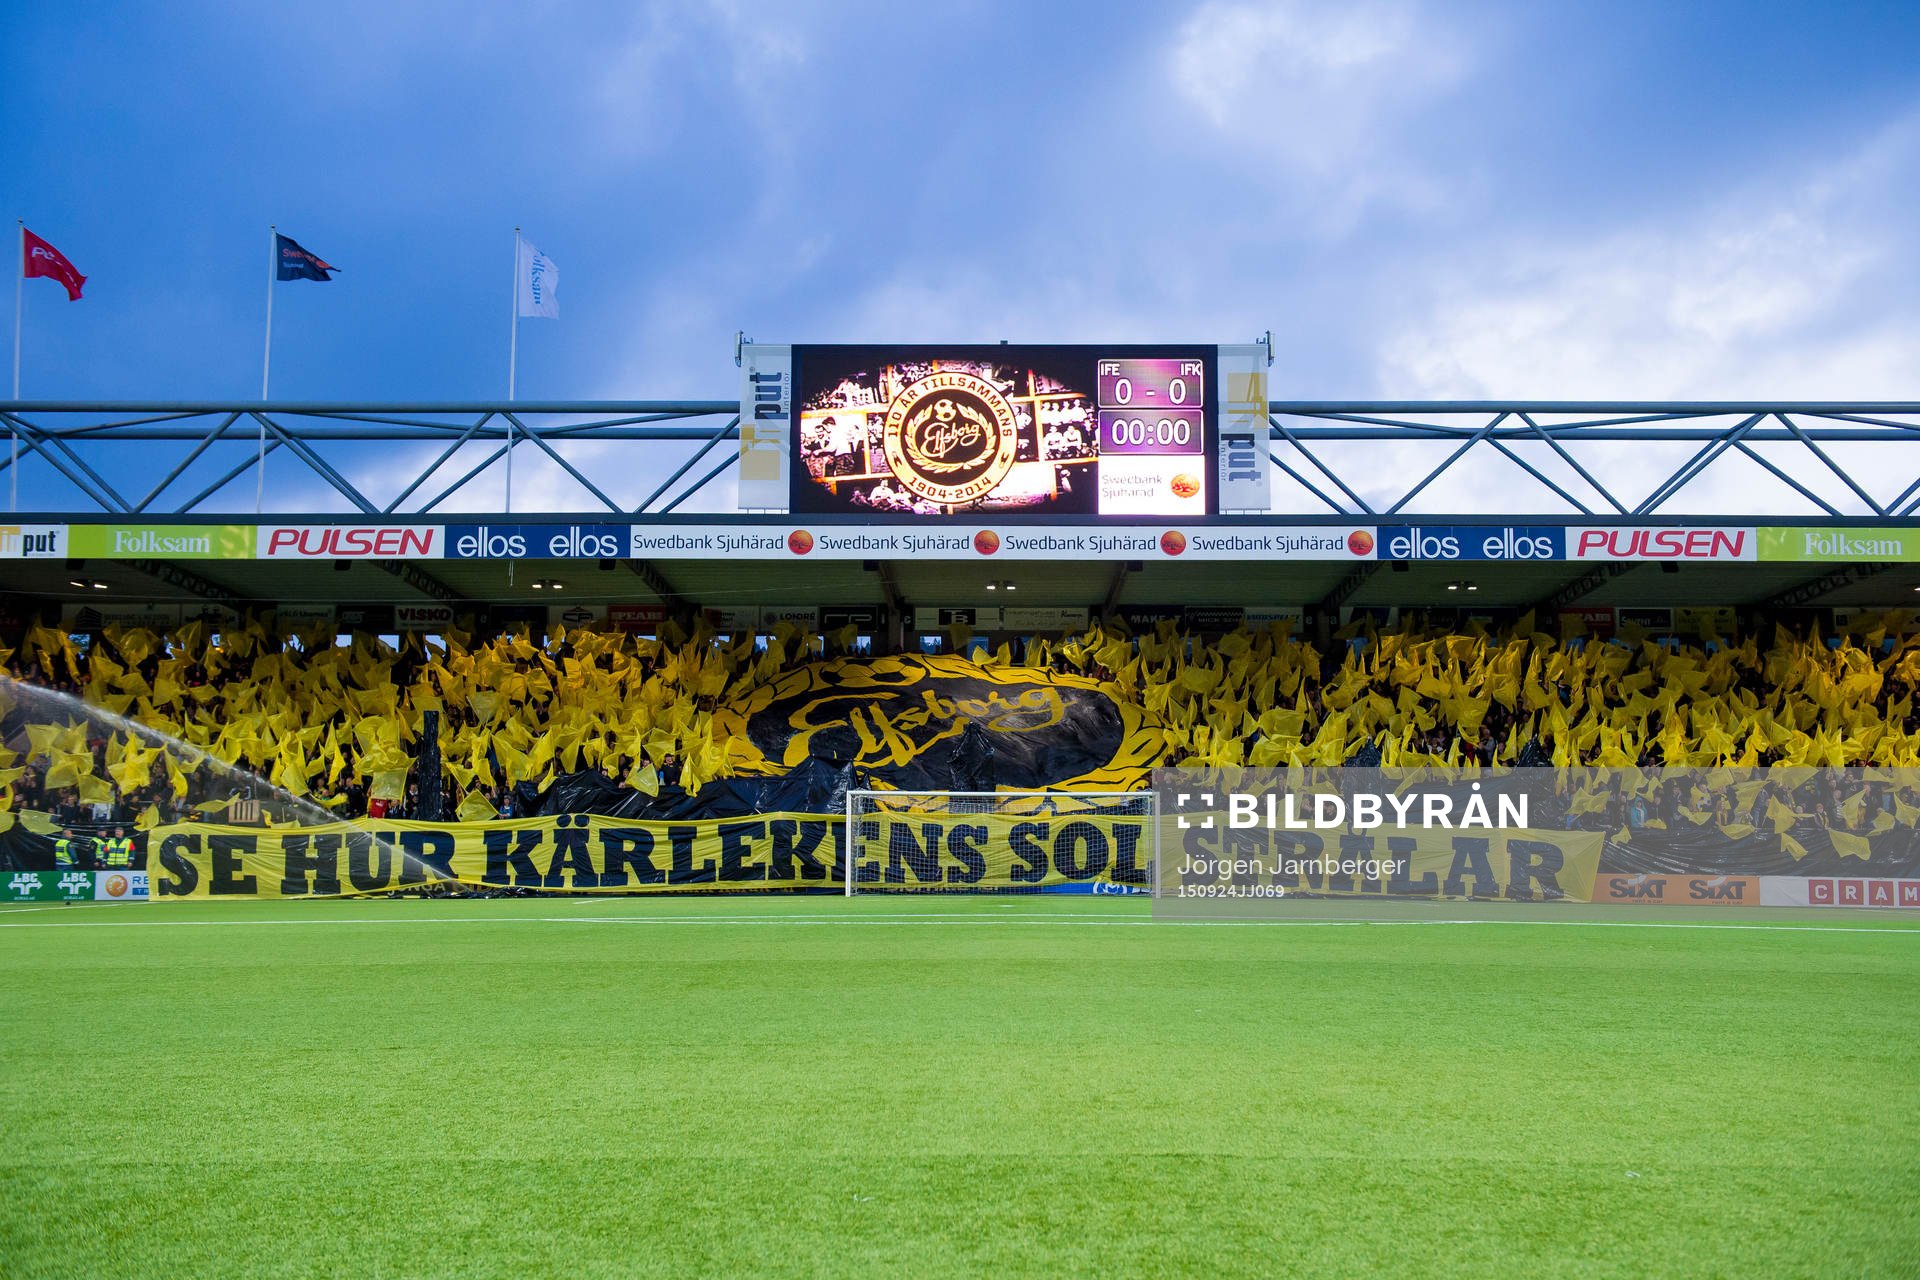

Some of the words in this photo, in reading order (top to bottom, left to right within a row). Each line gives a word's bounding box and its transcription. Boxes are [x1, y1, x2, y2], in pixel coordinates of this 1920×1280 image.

[1100, 363, 1121, 376] IFE
[1180, 363, 1201, 376] IFK
[1115, 378, 1132, 405] 0
[1168, 378, 1186, 405] 0
[888, 413, 902, 437] 110
[921, 376, 1013, 437] TILLSAMMANS
[919, 422, 981, 458] Elfsborg
[1111, 418, 1191, 446] 00:00
[908, 476, 992, 499] 1904-2014
[114, 530, 210, 553] Folksam
[267, 529, 433, 555] PULSEN
[457, 527, 526, 557] ellos
[549, 527, 618, 557] ellos
[633, 534, 712, 550] Swedbank
[716, 534, 784, 552] Sjuhärad
[819, 535, 898, 550] Swedbank
[902, 535, 970, 552] Sjuhärad
[1005, 535, 1085, 551] Swedbank
[1089, 535, 1156, 553] Sjuhärad
[1192, 536, 1272, 551] Swedbank
[1276, 536, 1344, 553] Sjuhärad
[1389, 527, 1460, 559] ellos
[1482, 527, 1553, 559] ellos
[1577, 530, 1745, 557] PULSEN
[1804, 532, 1902, 556] Folksam
[398, 608, 452, 621] VISKO
[611, 611, 663, 621] PEAB
[157, 833, 258, 897] SE
[280, 830, 460, 892] HUR
[482, 814, 990, 889] KÄRLEKENS
[1007, 821, 1149, 884] SOL
[13, 873, 39, 883] LBC
[63, 873, 88, 882] LBC
[1609, 876, 1667, 899] SIXT
[1689, 877, 1747, 900] SIXT
[1814, 884, 1919, 901] CRAM
